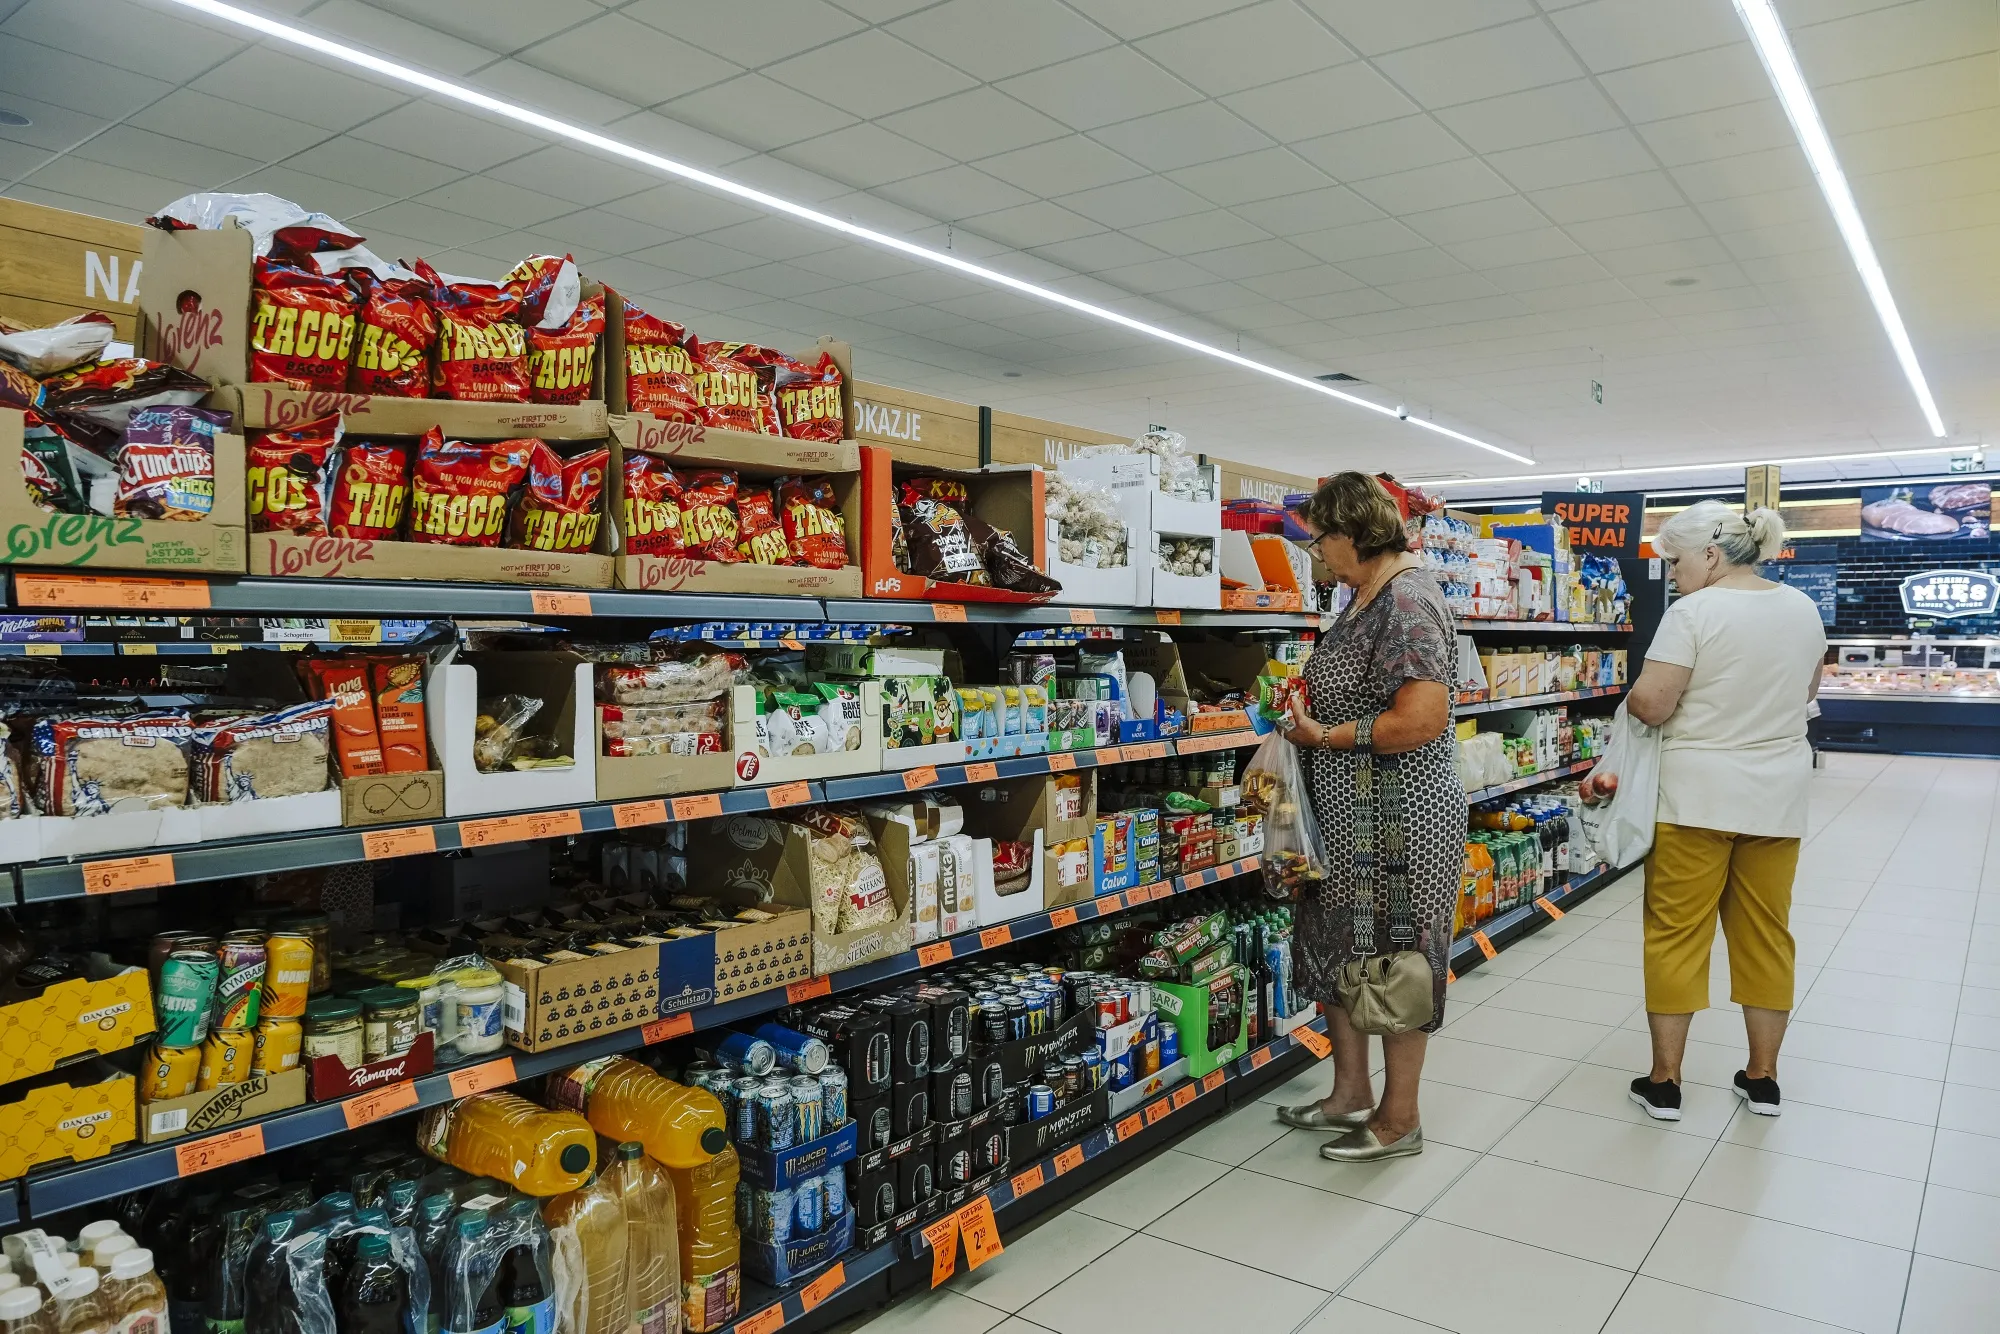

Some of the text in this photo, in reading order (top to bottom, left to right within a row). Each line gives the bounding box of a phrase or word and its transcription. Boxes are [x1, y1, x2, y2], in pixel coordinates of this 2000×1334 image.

[285, 361, 335, 375] BACON
[472, 361, 513, 374] BACON
[646, 377, 677, 386] BACON
[263, 388, 371, 429] Lorenz
[724, 408, 752, 418] BACON
[521, 414, 541, 423] FIRST
[543, 414, 557, 422] JOB
[853, 400, 922, 442] OKAZJE
[636, 419, 706, 455] Lorenz
[123, 448, 212, 485] Crunchips
[455, 474, 472, 485] YOU
[1240, 477, 1288, 505] NAJLEPSZE
[1555, 502, 1630, 524] SUPER
[0, 513, 145, 566] orenz
[151, 540, 184, 549] NOT MY
[635, 533, 670, 548] BACON
[145, 548, 194, 558] LAST JOB
[145, 557, 202, 565] #RECYCLABLE
[268, 537, 374, 577] Lorenz
[525, 563, 545, 572] FIRST
[547, 563, 561, 571] JOB
[639, 557, 706, 591] Lorenz
[0, 616, 66, 633] Milka MMMAX
[27, 632, 42, 640] Milka
[284, 631, 313, 640] Schogetten
[329, 676, 364, 697] Long
[333, 688, 366, 711] Chips
[841, 702, 861, 711] BAKE
[77, 726, 192, 739] GRILL BREAD
[360, 754, 382, 763] SNACK
[746, 755, 758, 777] DAYS
[368, 805, 386, 816] keep
[1139, 812, 1156, 823] Calvo
[1141, 836, 1159, 848] Calvo
[1138, 859, 1156, 871] Calvo
[858, 875, 884, 894] SIEKANY
[1101, 876, 1128, 892] Calvo
[846, 937, 884, 964] SIEKANY
[667, 993, 706, 1009] Schulstad
[1152, 991, 1179, 1011] BARK
[83, 1003, 131, 1023] DAN CAKE
[806, 1024, 829, 1038] BLACK
[349, 1060, 405, 1087] Pamapol
[191, 1078, 264, 1131] TYMBARK
[62, 1111, 110, 1129] DAN CAKE
[890, 1138, 913, 1155] BLACK
[797, 1147, 827, 1166] JUICED
[896, 1209, 918, 1227] BLACK
